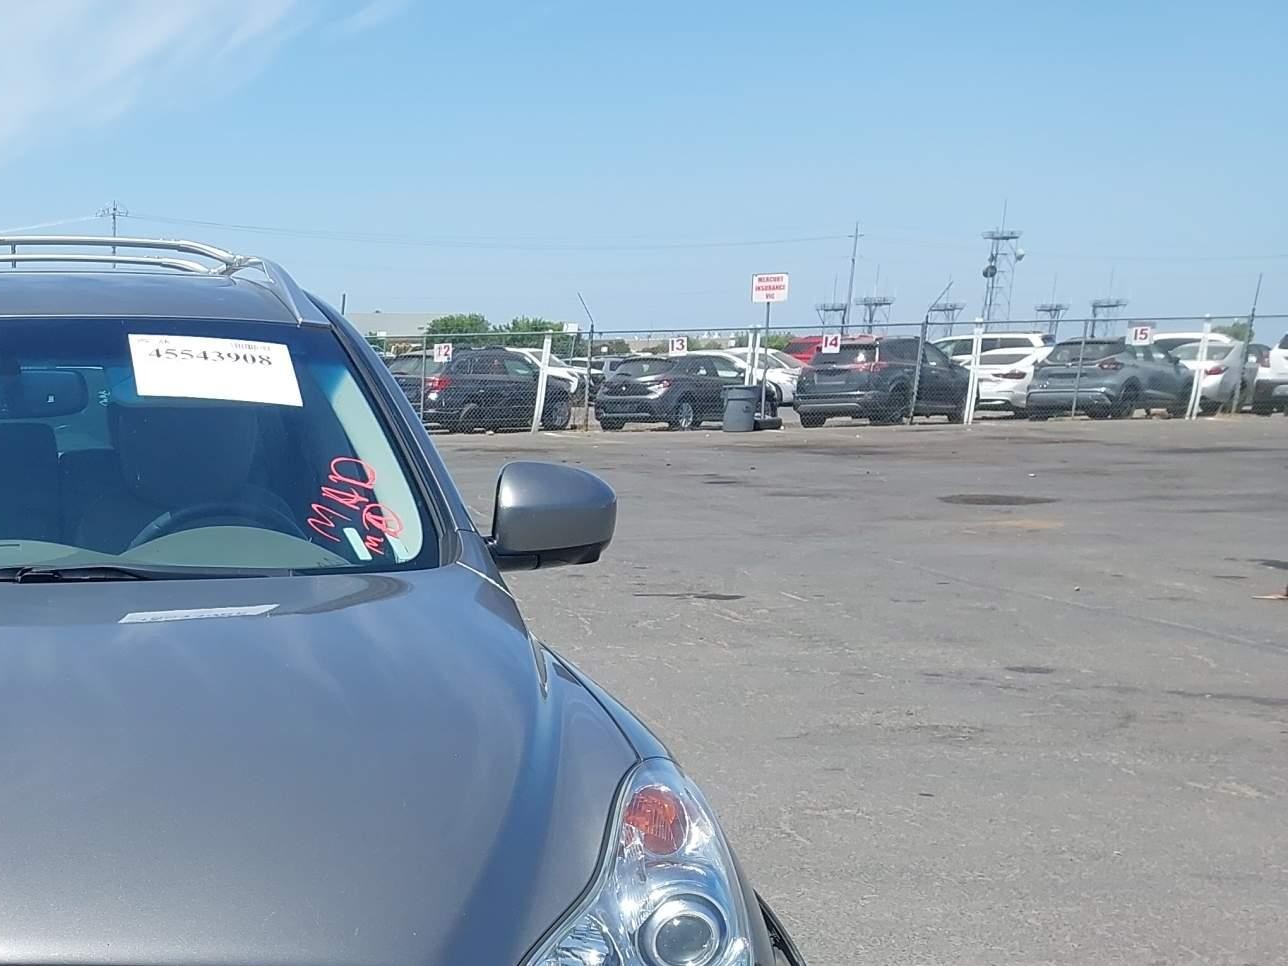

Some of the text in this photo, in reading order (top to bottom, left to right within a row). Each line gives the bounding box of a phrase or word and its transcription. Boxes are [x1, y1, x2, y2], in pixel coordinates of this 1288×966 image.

[1134, 328, 1149, 340] 15
[671, 338, 685, 352] 13
[824, 335, 839, 348] 14
[437, 344, 450, 357] 12
[149, 348, 272, 367] 45543908
